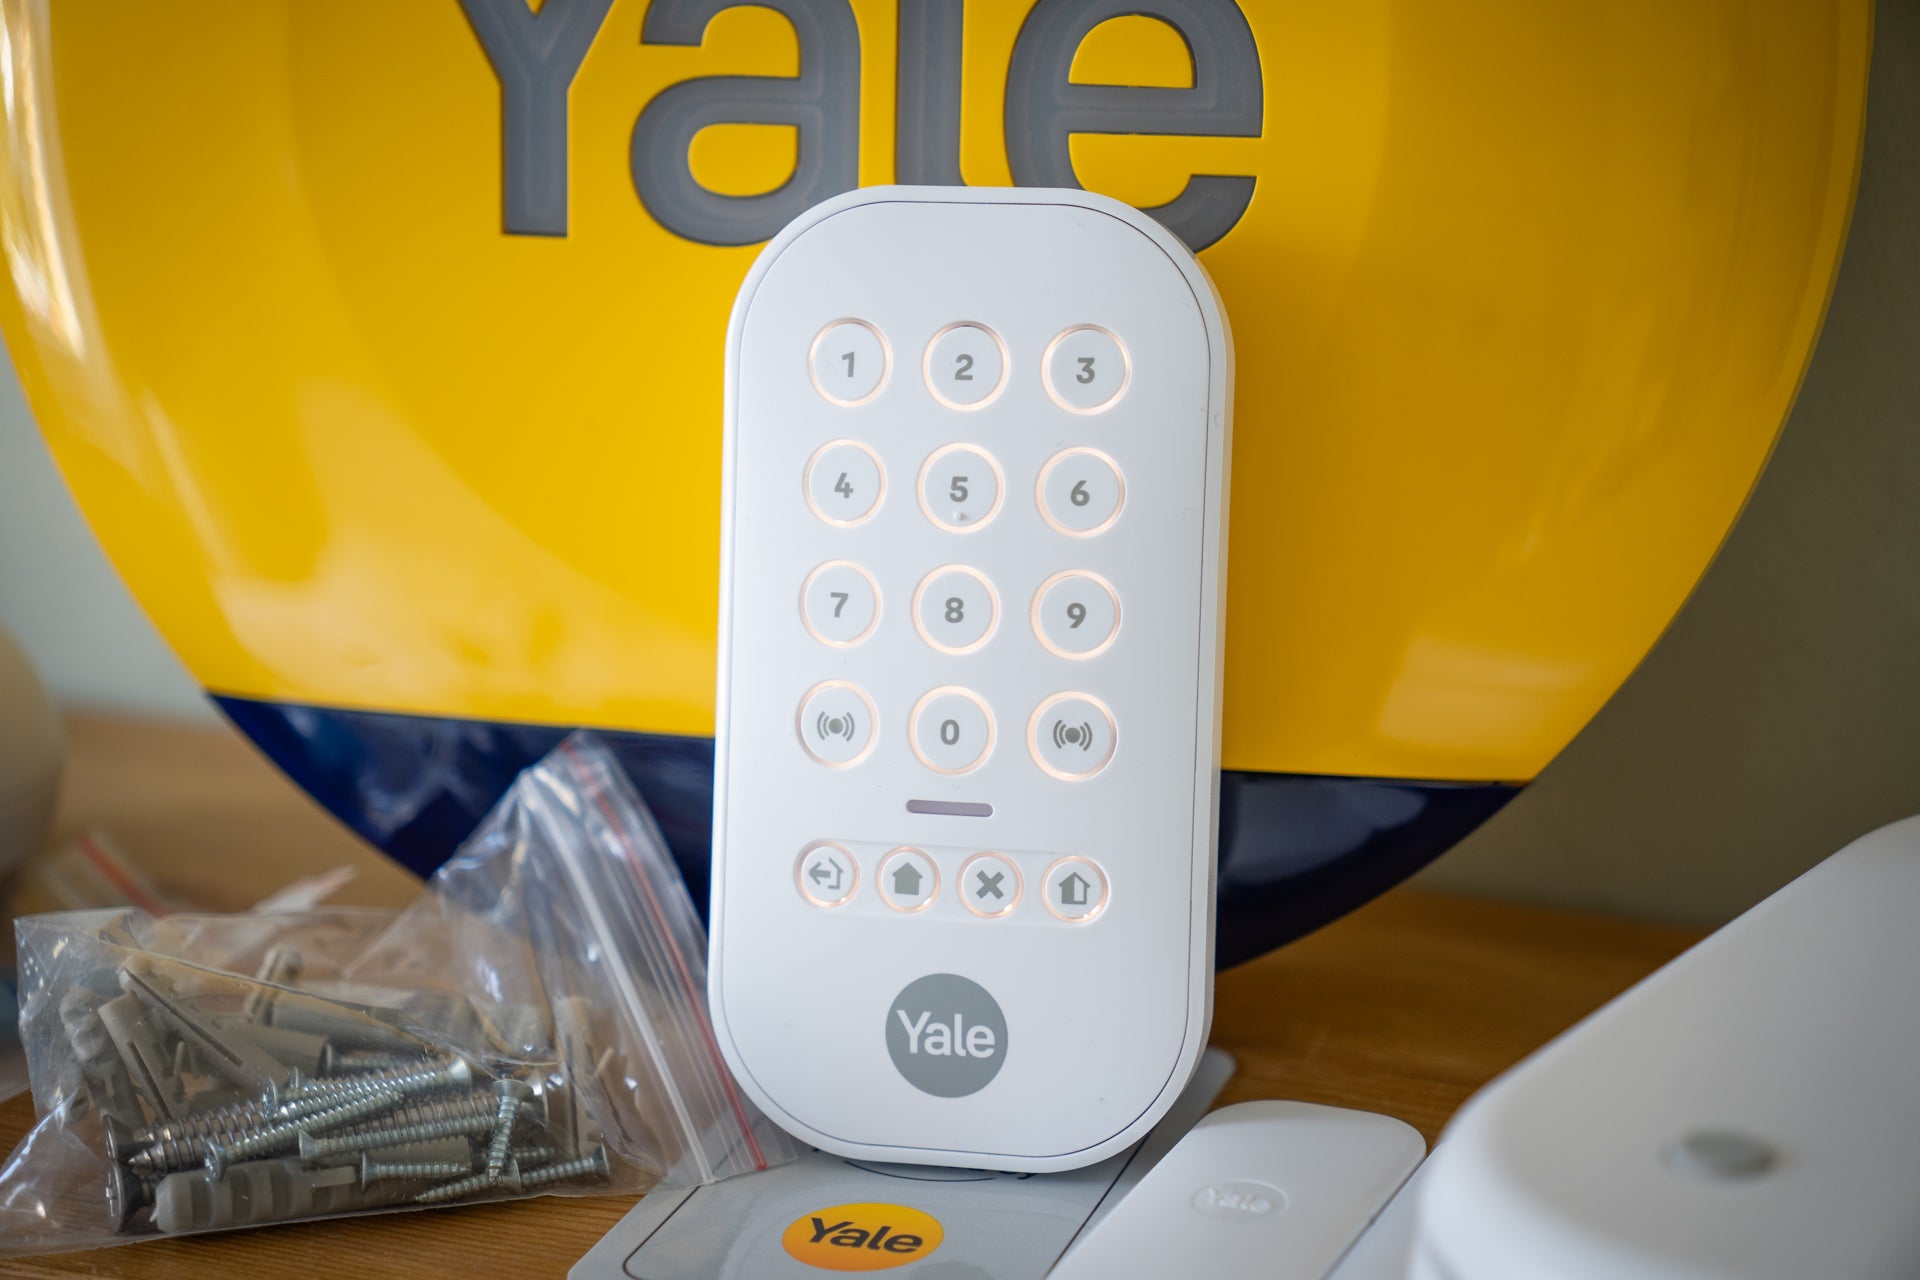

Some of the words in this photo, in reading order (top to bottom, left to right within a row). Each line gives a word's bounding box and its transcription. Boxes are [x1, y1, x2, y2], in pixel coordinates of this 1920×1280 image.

[840, 351, 855, 378] 1
[954, 353, 974, 381] 2
[1075, 357, 1096, 385] 3
[833, 472, 854, 499] 4
[949, 475, 969, 503] 5
[1070, 479, 1091, 507] 6
[830, 591, 849, 618] 7
[944, 596, 965, 624] 8
[1066, 602, 1087, 629] 9
[940, 719, 960, 746] 0
[896, 1009, 996, 1059] Yale
[809, 1217, 924, 1254] Yale
